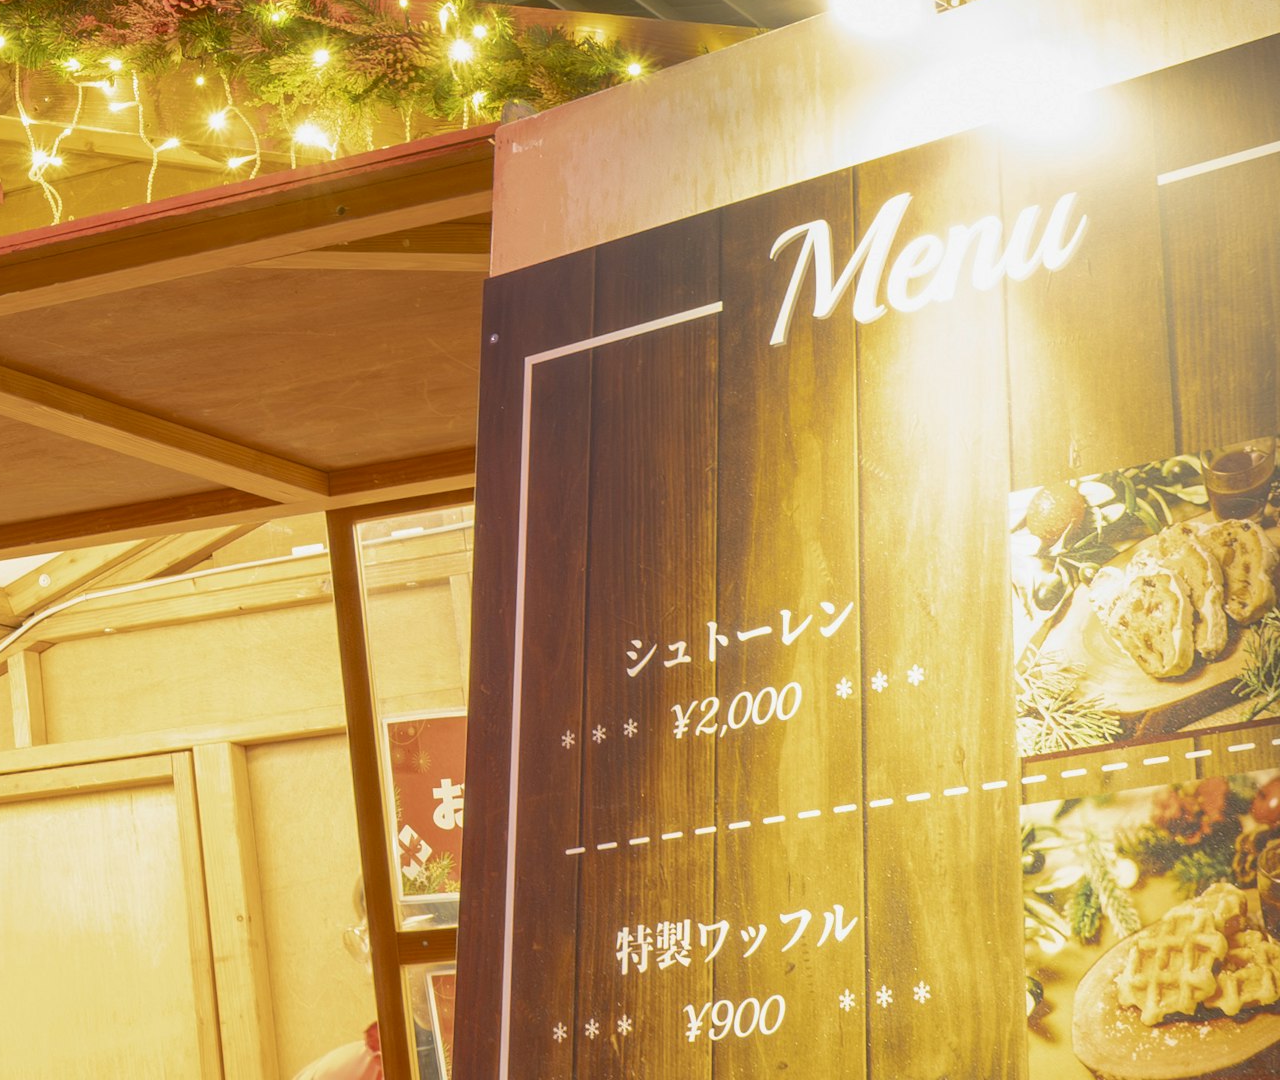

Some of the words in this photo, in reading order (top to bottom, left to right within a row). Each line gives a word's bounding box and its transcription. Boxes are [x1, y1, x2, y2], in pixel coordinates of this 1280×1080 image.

[769, 191, 1088, 347] Menu
[626, 601, 854, 677] シュトーレン
[670, 681, 802, 739] ¥2,000
[615, 904, 858, 976] 特製ワッフル
[683, 994, 786, 1043] ¥900
